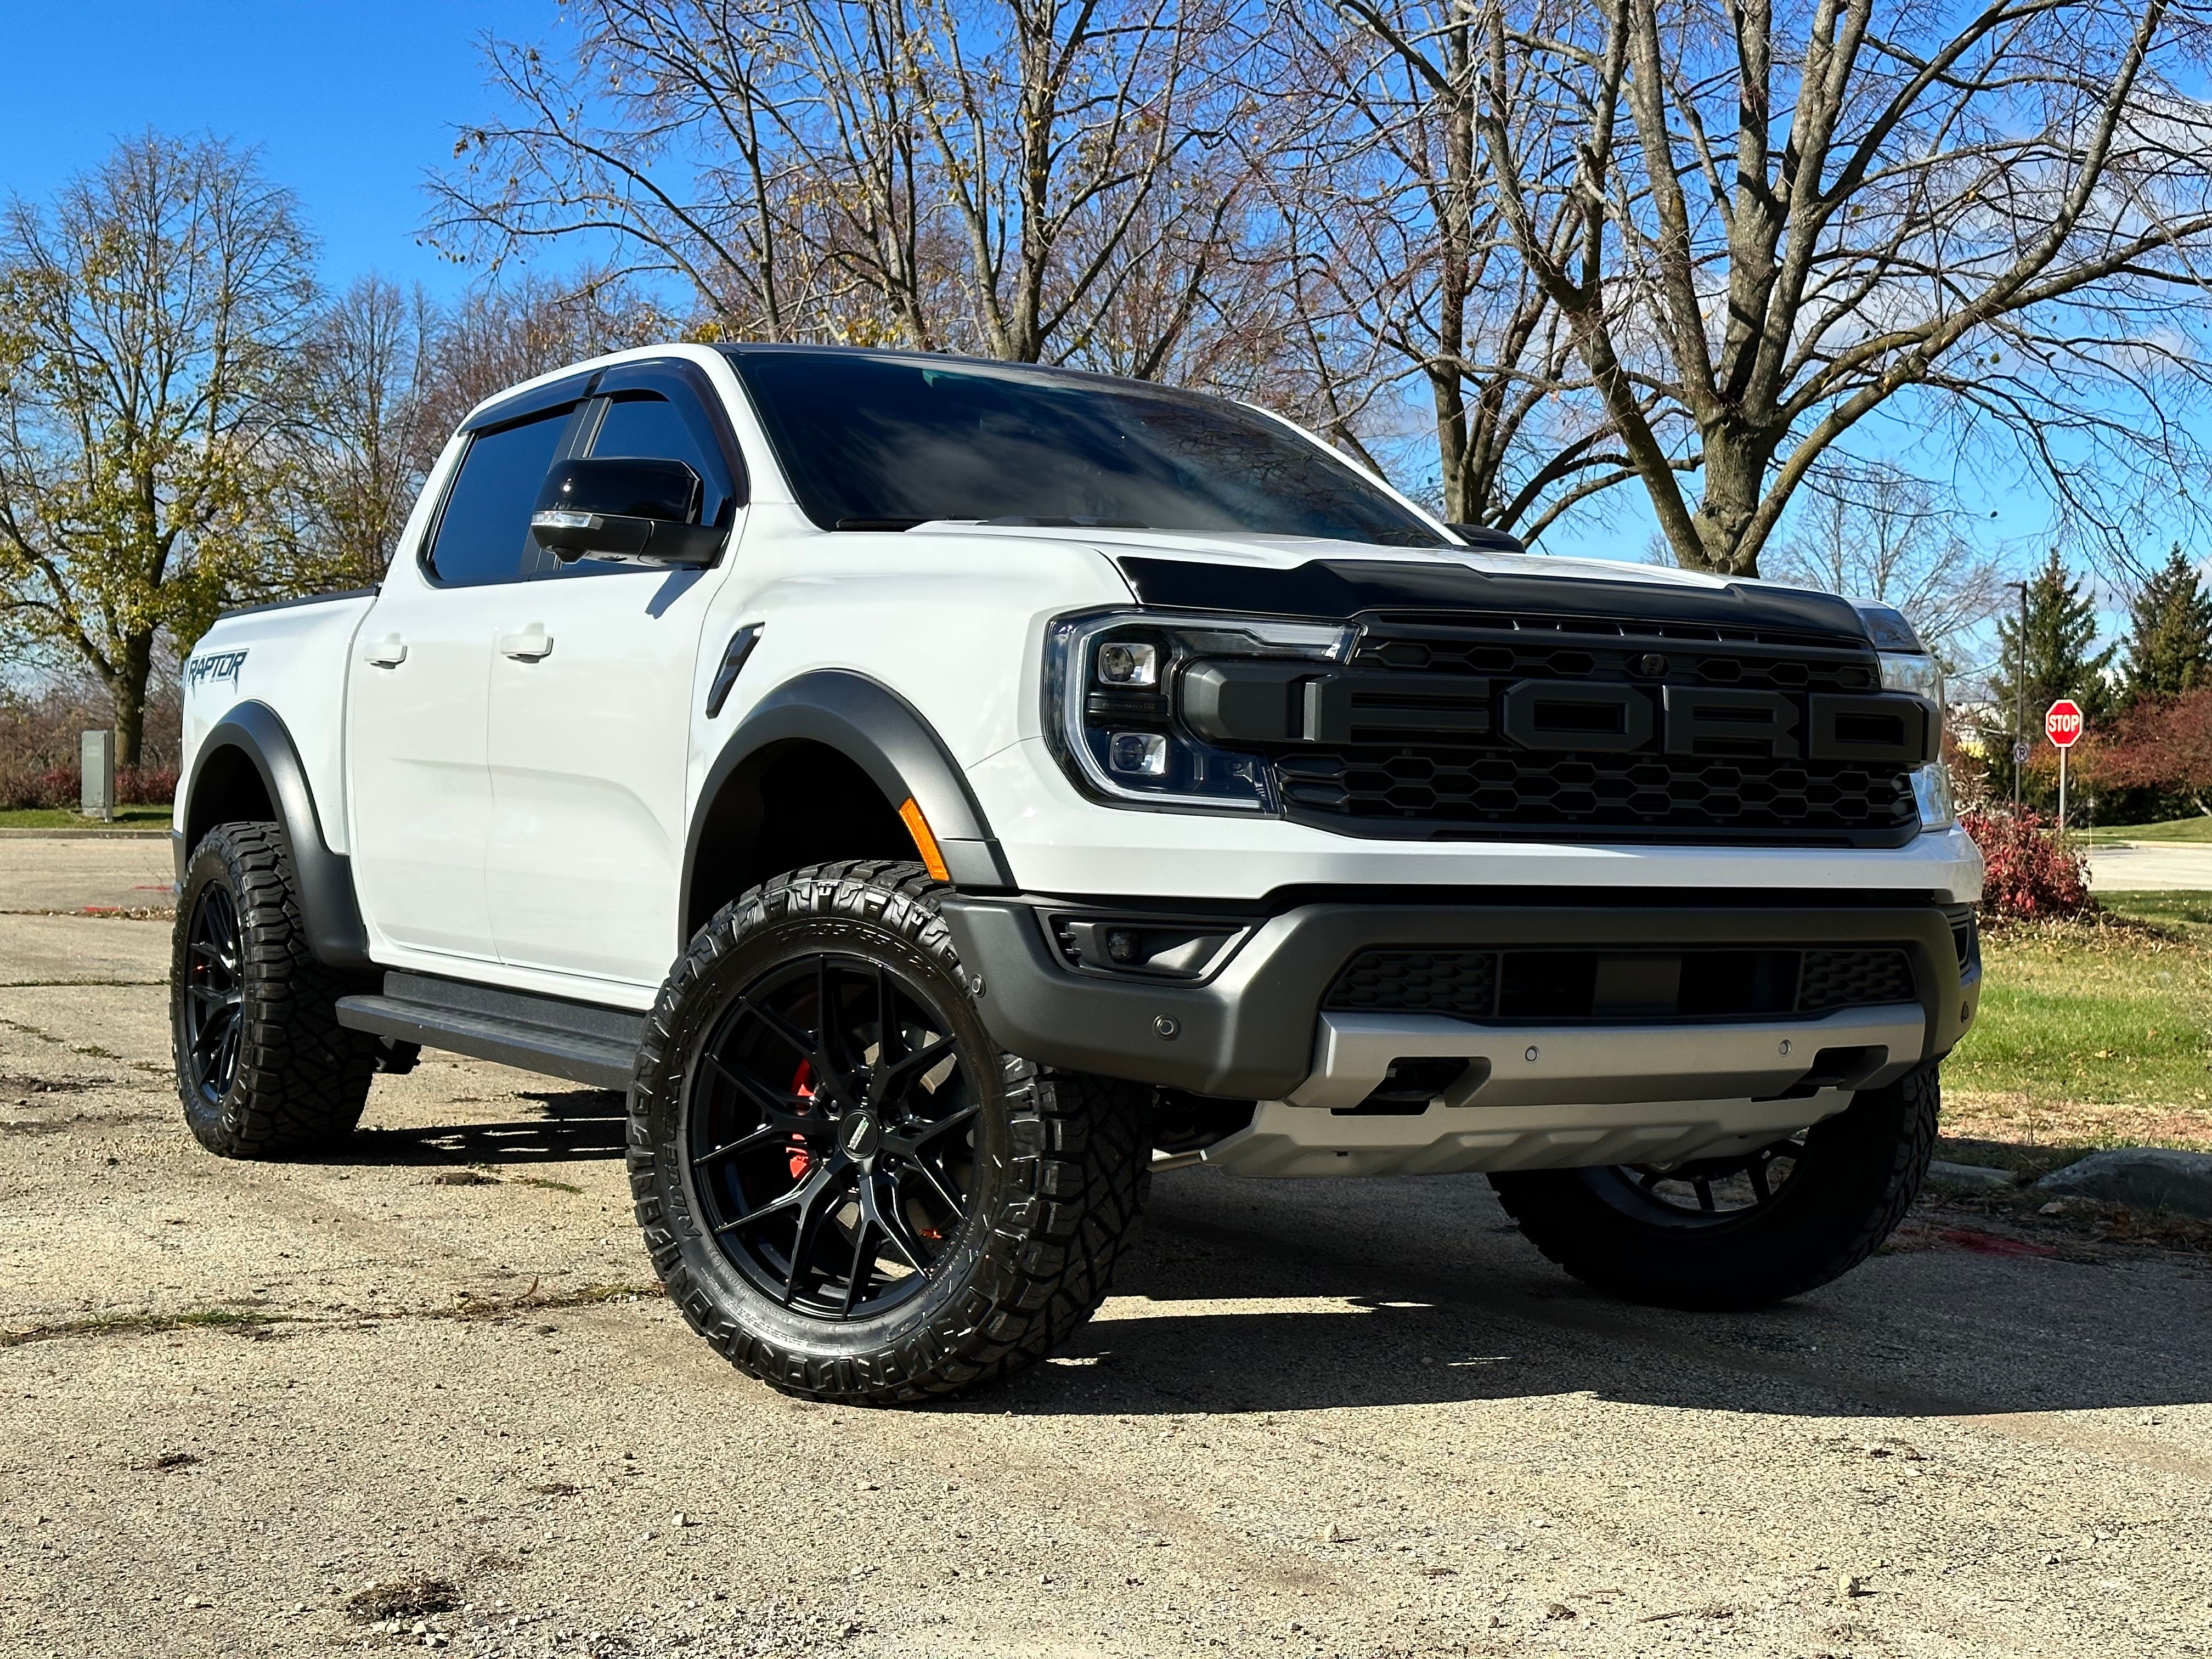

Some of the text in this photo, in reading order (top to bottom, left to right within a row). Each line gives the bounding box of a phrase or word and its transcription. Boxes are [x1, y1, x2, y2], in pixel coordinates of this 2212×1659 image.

[188, 650, 249, 695] RAPTOR
[1304, 673, 1939, 761] FORD
[2049, 714, 2079, 732] STOP
